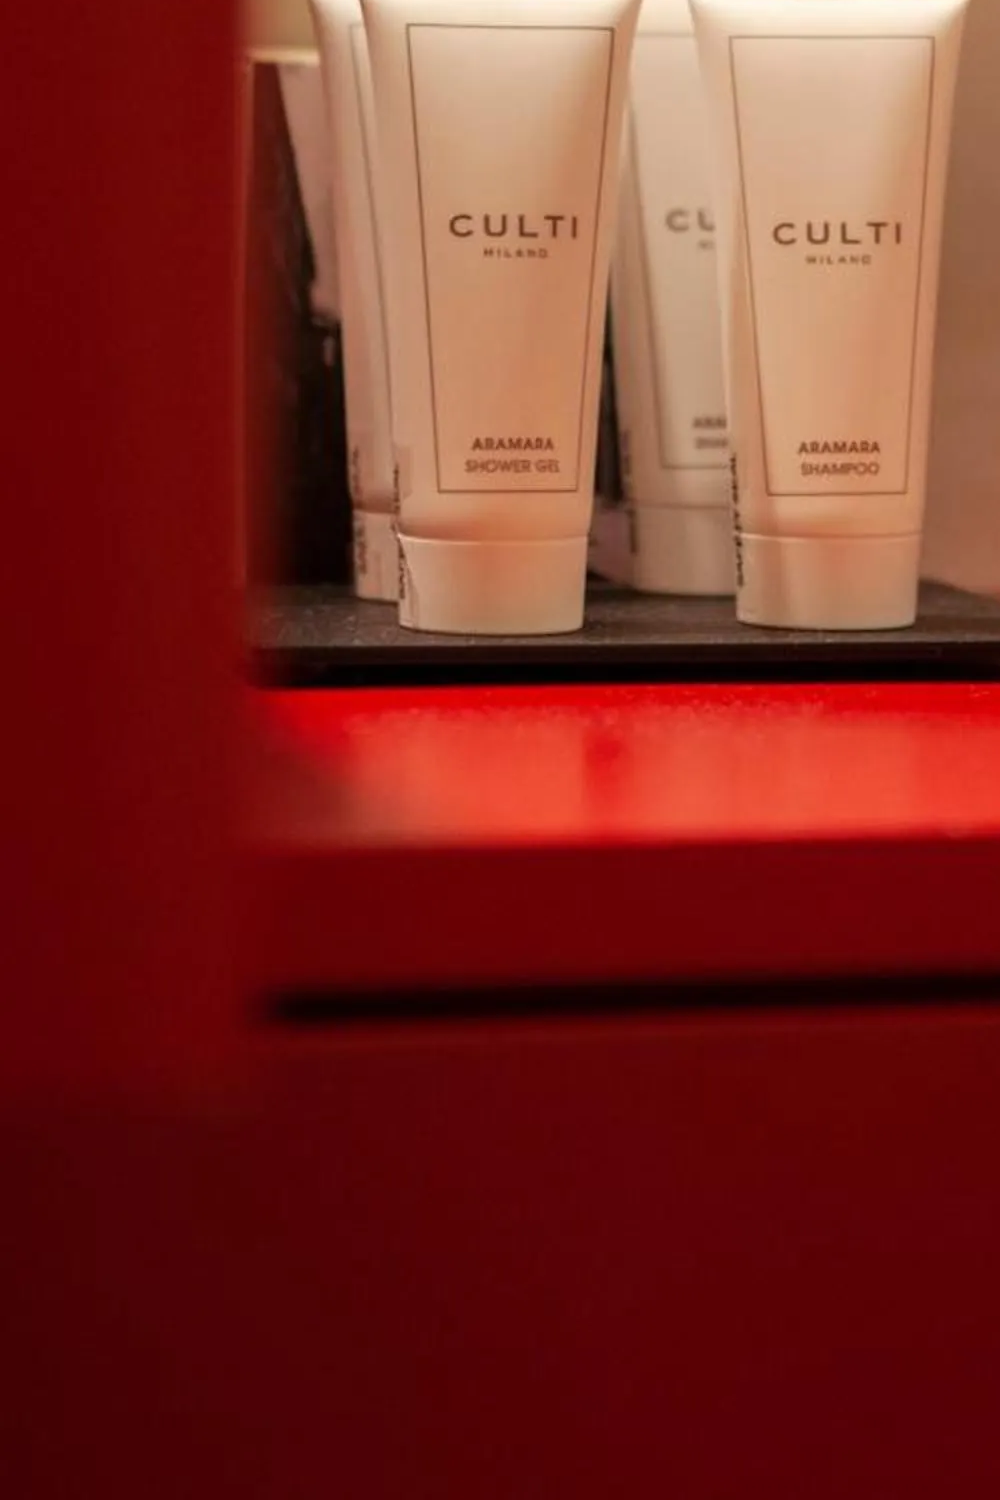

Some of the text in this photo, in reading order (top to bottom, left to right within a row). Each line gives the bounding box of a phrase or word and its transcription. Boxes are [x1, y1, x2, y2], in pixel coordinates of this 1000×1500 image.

[449, 213, 578, 239] CULTI
[772, 221, 903, 246] CULTI
[482, 248, 548, 259] MILANO
[804, 255, 872, 265] MILANO
[471, 437, 555, 451] ARAMARA
[799, 441, 881, 454] ARAMARA
[464, 459, 531, 473] SHOWER
[800, 462, 880, 476] SHAMPOO
